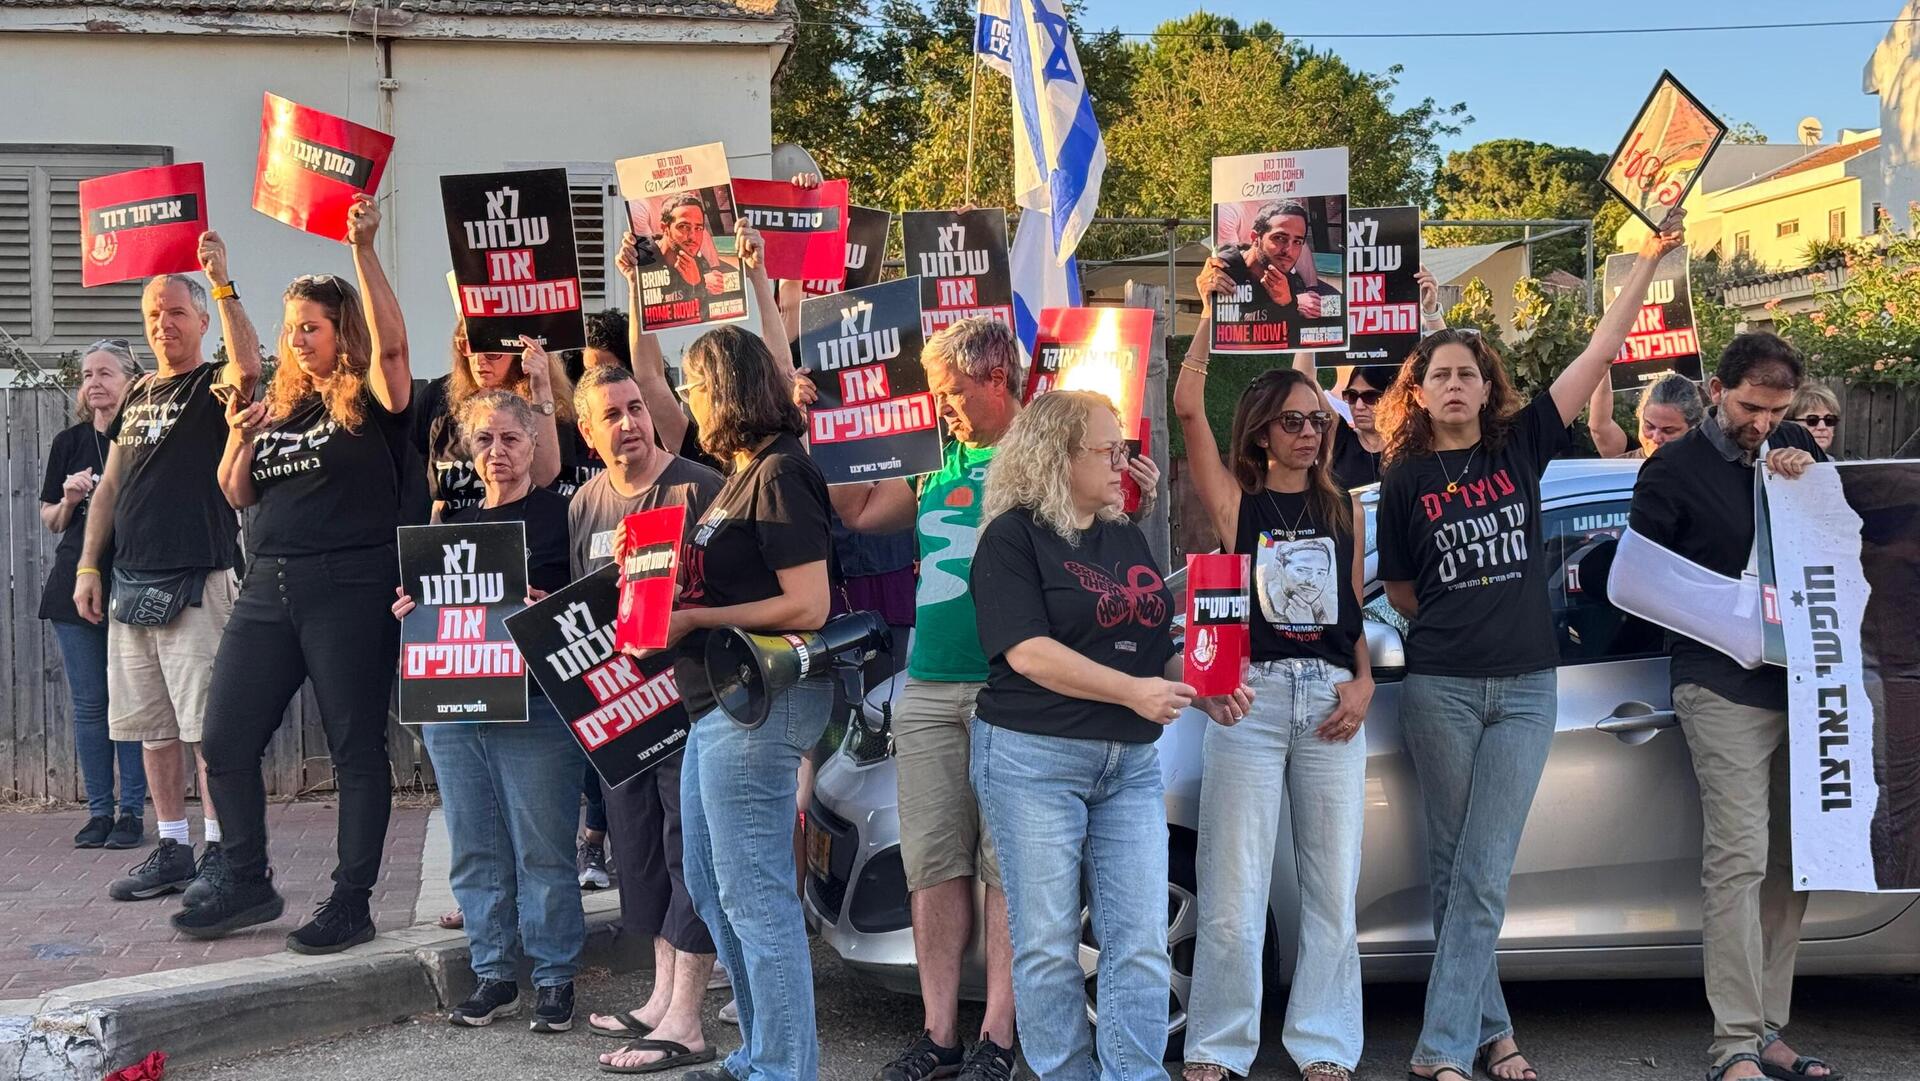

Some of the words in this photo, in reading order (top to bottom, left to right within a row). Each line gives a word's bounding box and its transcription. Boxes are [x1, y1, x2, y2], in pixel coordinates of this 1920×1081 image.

[323, 151, 356, 177] מתן
[652, 167, 673, 180] NIMROD
[674, 164, 693, 176] COHEN
[1254, 170, 1280, 183] NIMROD
[1282, 169, 1305, 180] COHEN
[1263, 159, 1275, 171] כהן
[1276, 157, 1295, 169] נמרוד
[128, 199, 183, 225] אביתר
[486, 186, 520, 218] לא
[99, 209, 125, 230] דוד
[464, 216, 550, 249] שכחנו
[788, 212, 823, 228] סהר
[1349, 218, 1379, 247] לא
[937, 223, 966, 252] לא
[490, 251, 532, 280] את
[918, 250, 990, 278] שכחנו
[1349, 245, 1402, 272] שכח
[641, 269, 671, 289] BRING
[939, 280, 975, 307] את
[463, 280, 577, 314] החטופים
[643, 288, 662, 306] HIM
[645, 304, 672, 323] HOME
[673, 298, 700, 320] NOW!
[840, 301, 874, 337] לא
[1216, 304, 1241, 322] HIM
[1349, 304, 1416, 333] ההפק
[1216, 324, 1250, 342] HOME
[1252, 321, 1288, 342] NOW!
[817, 327, 901, 372] שכחנו
[843, 366, 887, 403] את
[813, 394, 935, 442] החטופים
[876, 458, 902, 470] חופשי
[1420, 469, 1516, 522] עוצרים
[1500, 502, 1526, 527] עד
[1433, 512, 1499, 552] שכולם
[442, 539, 477, 573] לא
[1438, 529, 1528, 583] חוזרים
[420, 572, 505, 605] שכחנו
[441, 609, 483, 640] את
[553, 601, 596, 644] לא
[1802, 565, 1844, 679] חופשי
[406, 642, 520, 677] החטופים
[587, 655, 640, 701] את
[437, 704, 463, 713] בארצנו
[464, 700, 487, 712] חופשי
[1817, 684, 1852, 812] בארצנו
